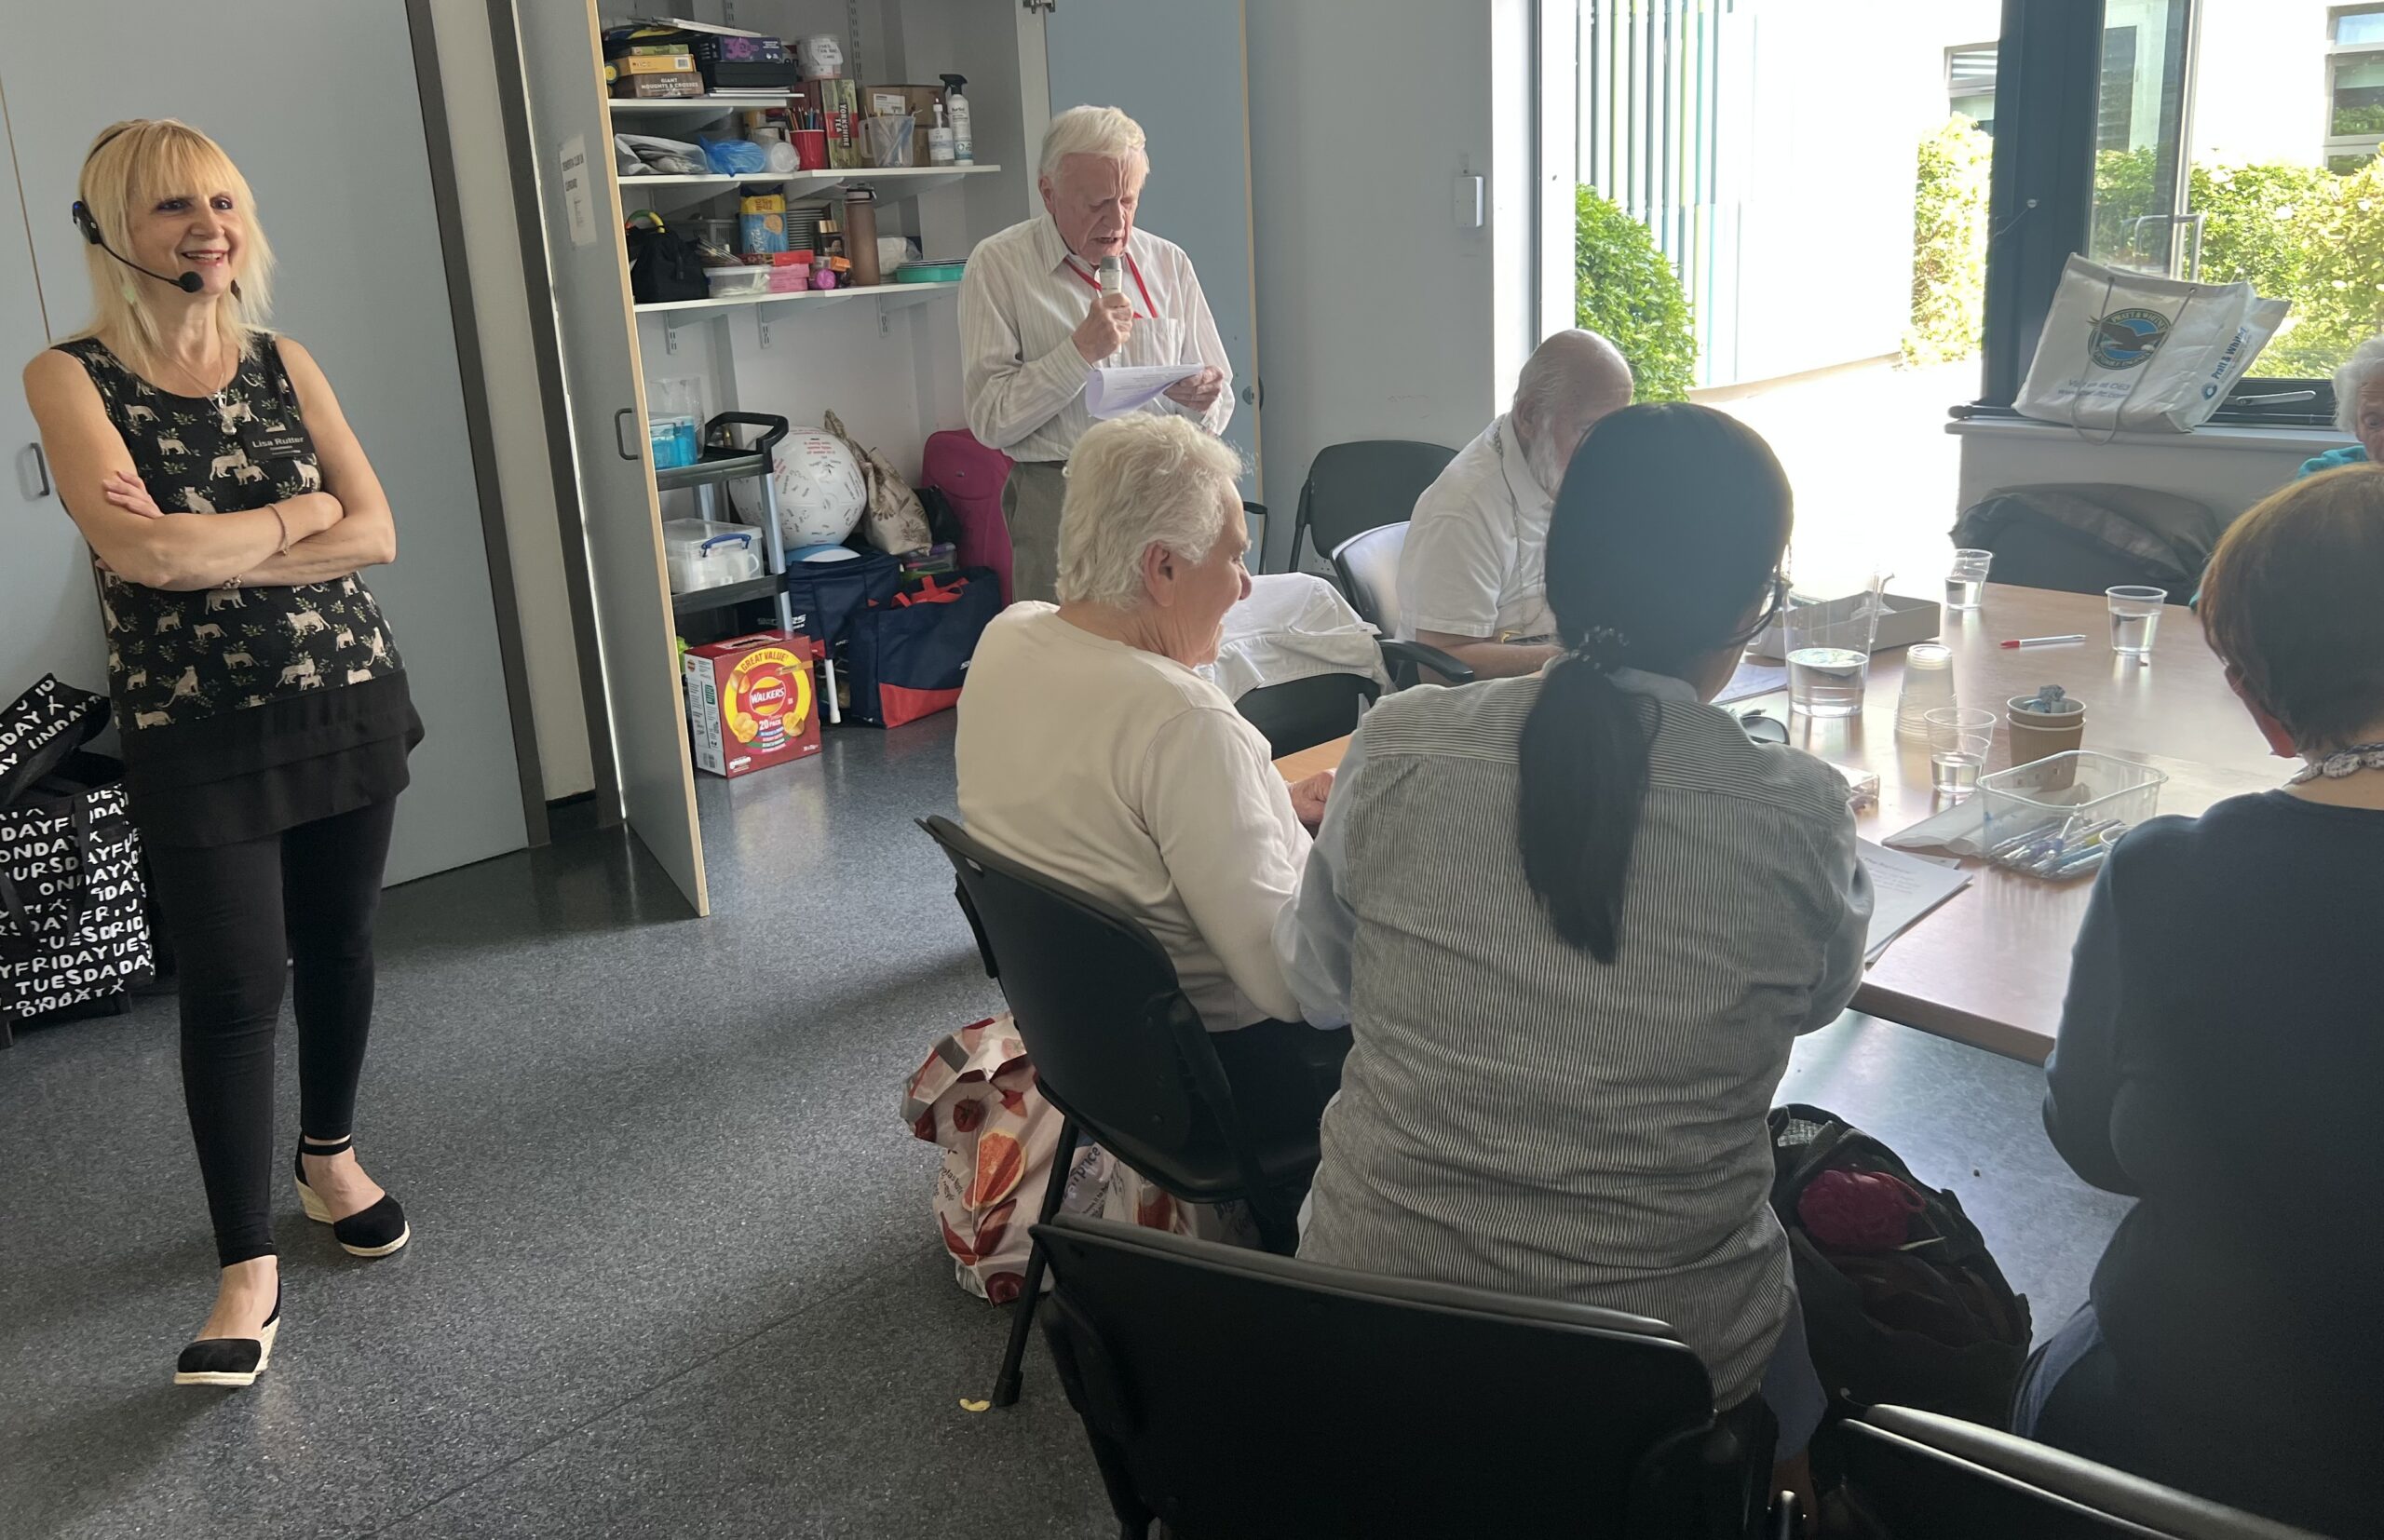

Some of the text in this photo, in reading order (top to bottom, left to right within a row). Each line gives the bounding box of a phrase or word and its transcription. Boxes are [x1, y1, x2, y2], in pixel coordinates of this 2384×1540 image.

[834, 118, 843, 133] TEA
[839, 103, 850, 147] YORKSHIRE
[251, 439, 274, 448] Lisa
[274, 436, 305, 446] Rutter
[740, 654, 763, 672] GREAT
[751, 687, 785, 705] WALKERS
[758, 719, 782, 731] 20 PACK
